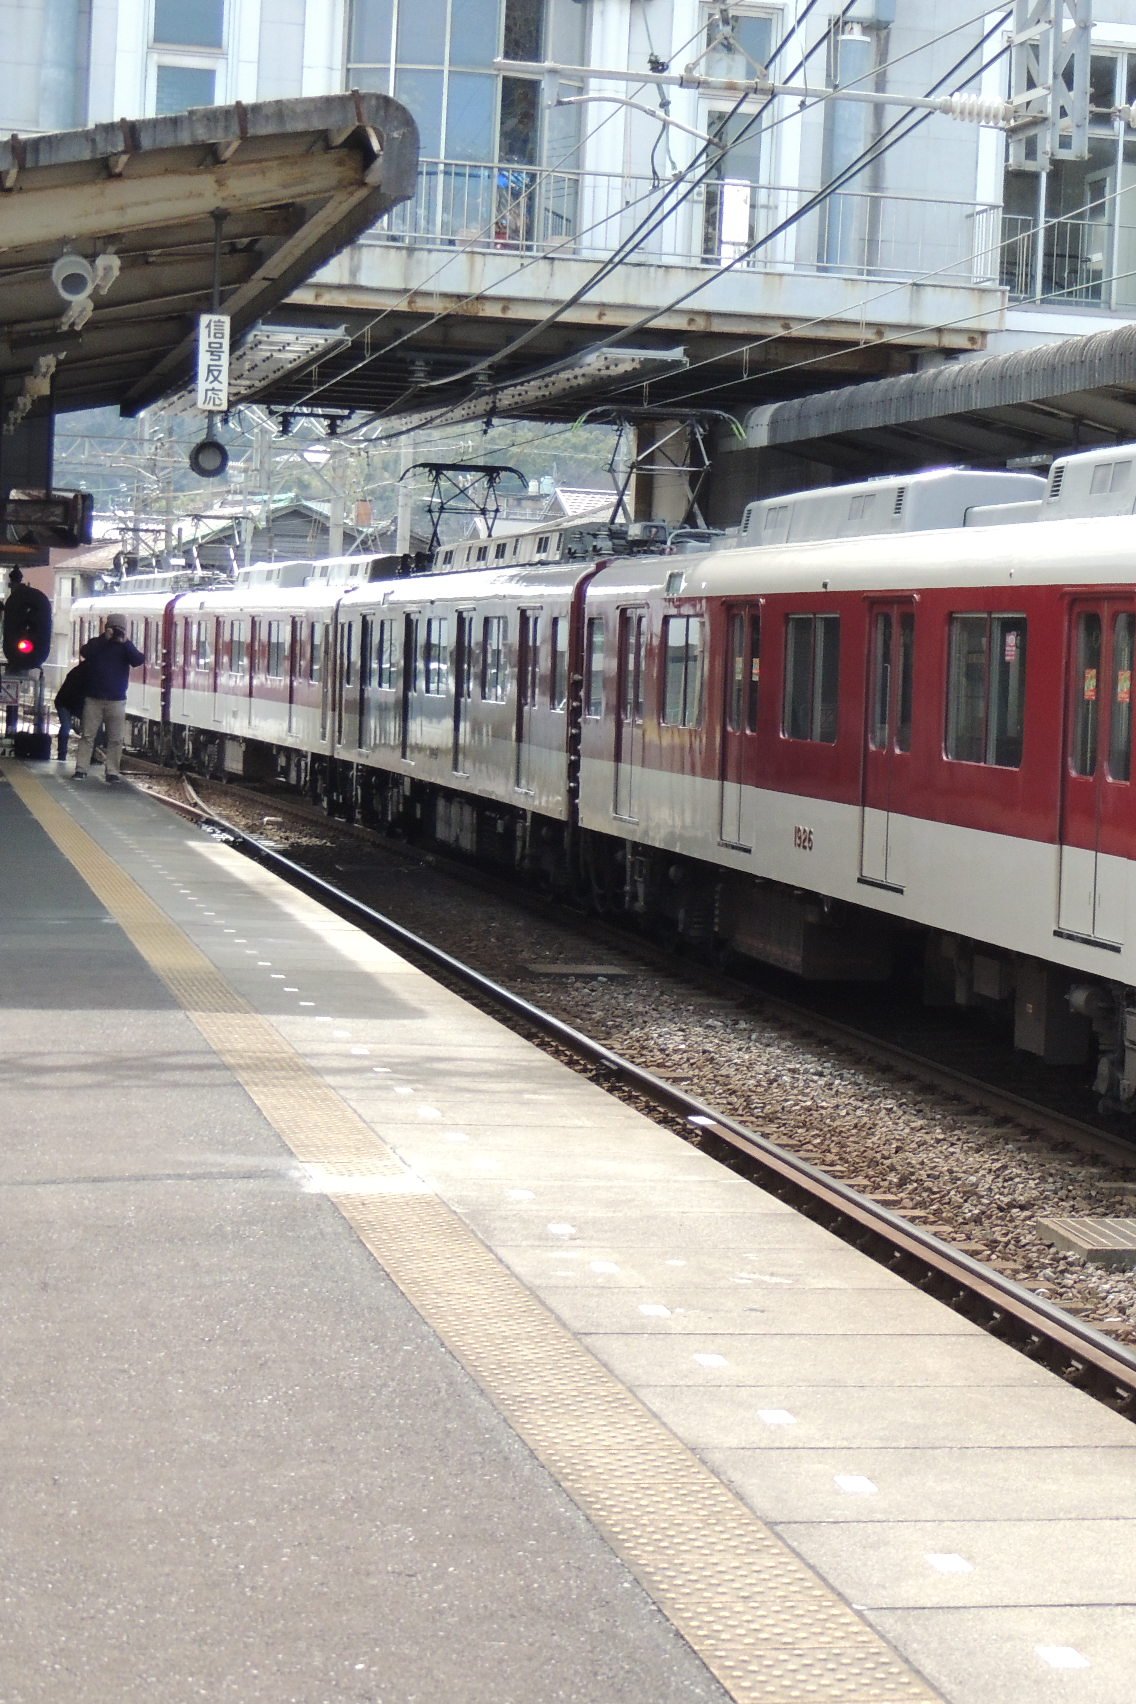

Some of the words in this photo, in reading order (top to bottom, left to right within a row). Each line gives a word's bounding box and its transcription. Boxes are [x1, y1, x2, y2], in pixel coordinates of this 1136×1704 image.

[203, 318, 226, 408] 信号反応
[793, 825, 814, 851] 1926
